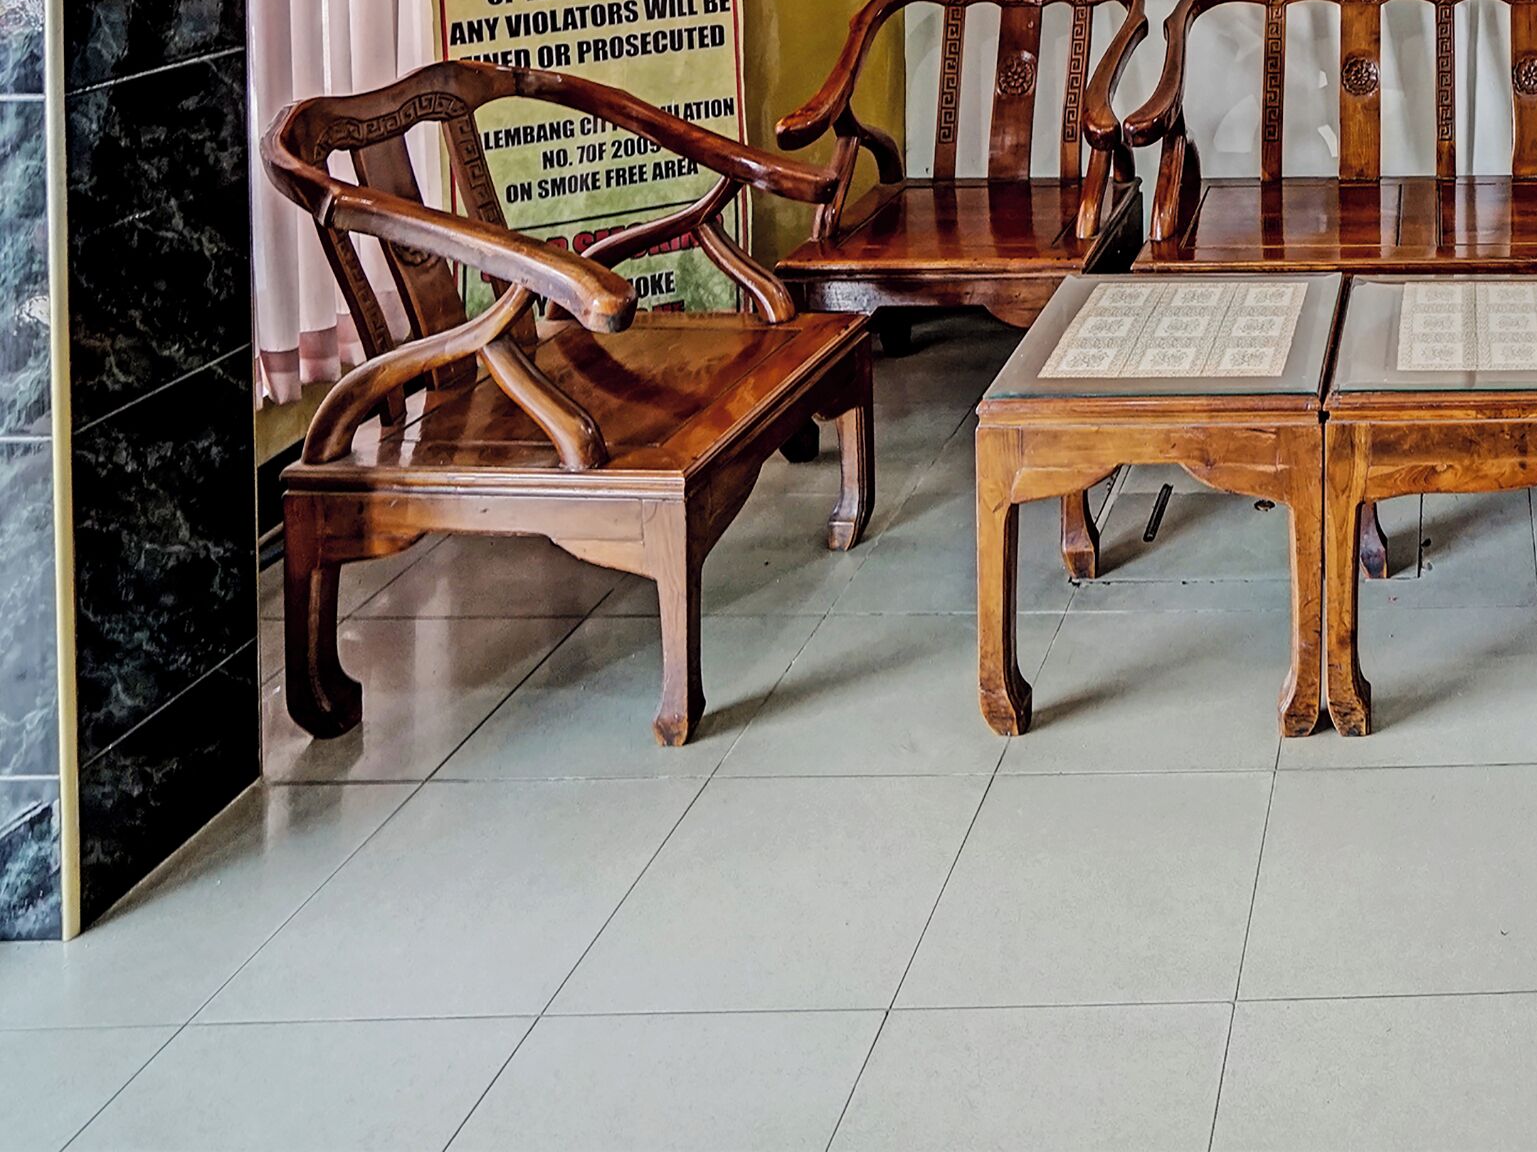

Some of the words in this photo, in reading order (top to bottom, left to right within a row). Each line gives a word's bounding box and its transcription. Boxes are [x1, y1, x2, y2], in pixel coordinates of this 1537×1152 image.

[450, 16, 500, 46] ANY
[504, 0, 639, 39] VIOLATORS
[537, 43, 571, 69] OR
[577, 24, 725, 64] PROSECUTED
[483, 119, 575, 151] LEMBANG
[505, 181, 533, 204] ON
[537, 171, 601, 199] SMOKE
[605, 163, 648, 189] FREE
[651, 157, 700, 182] AREA
[542, 148, 573, 170] NO.
